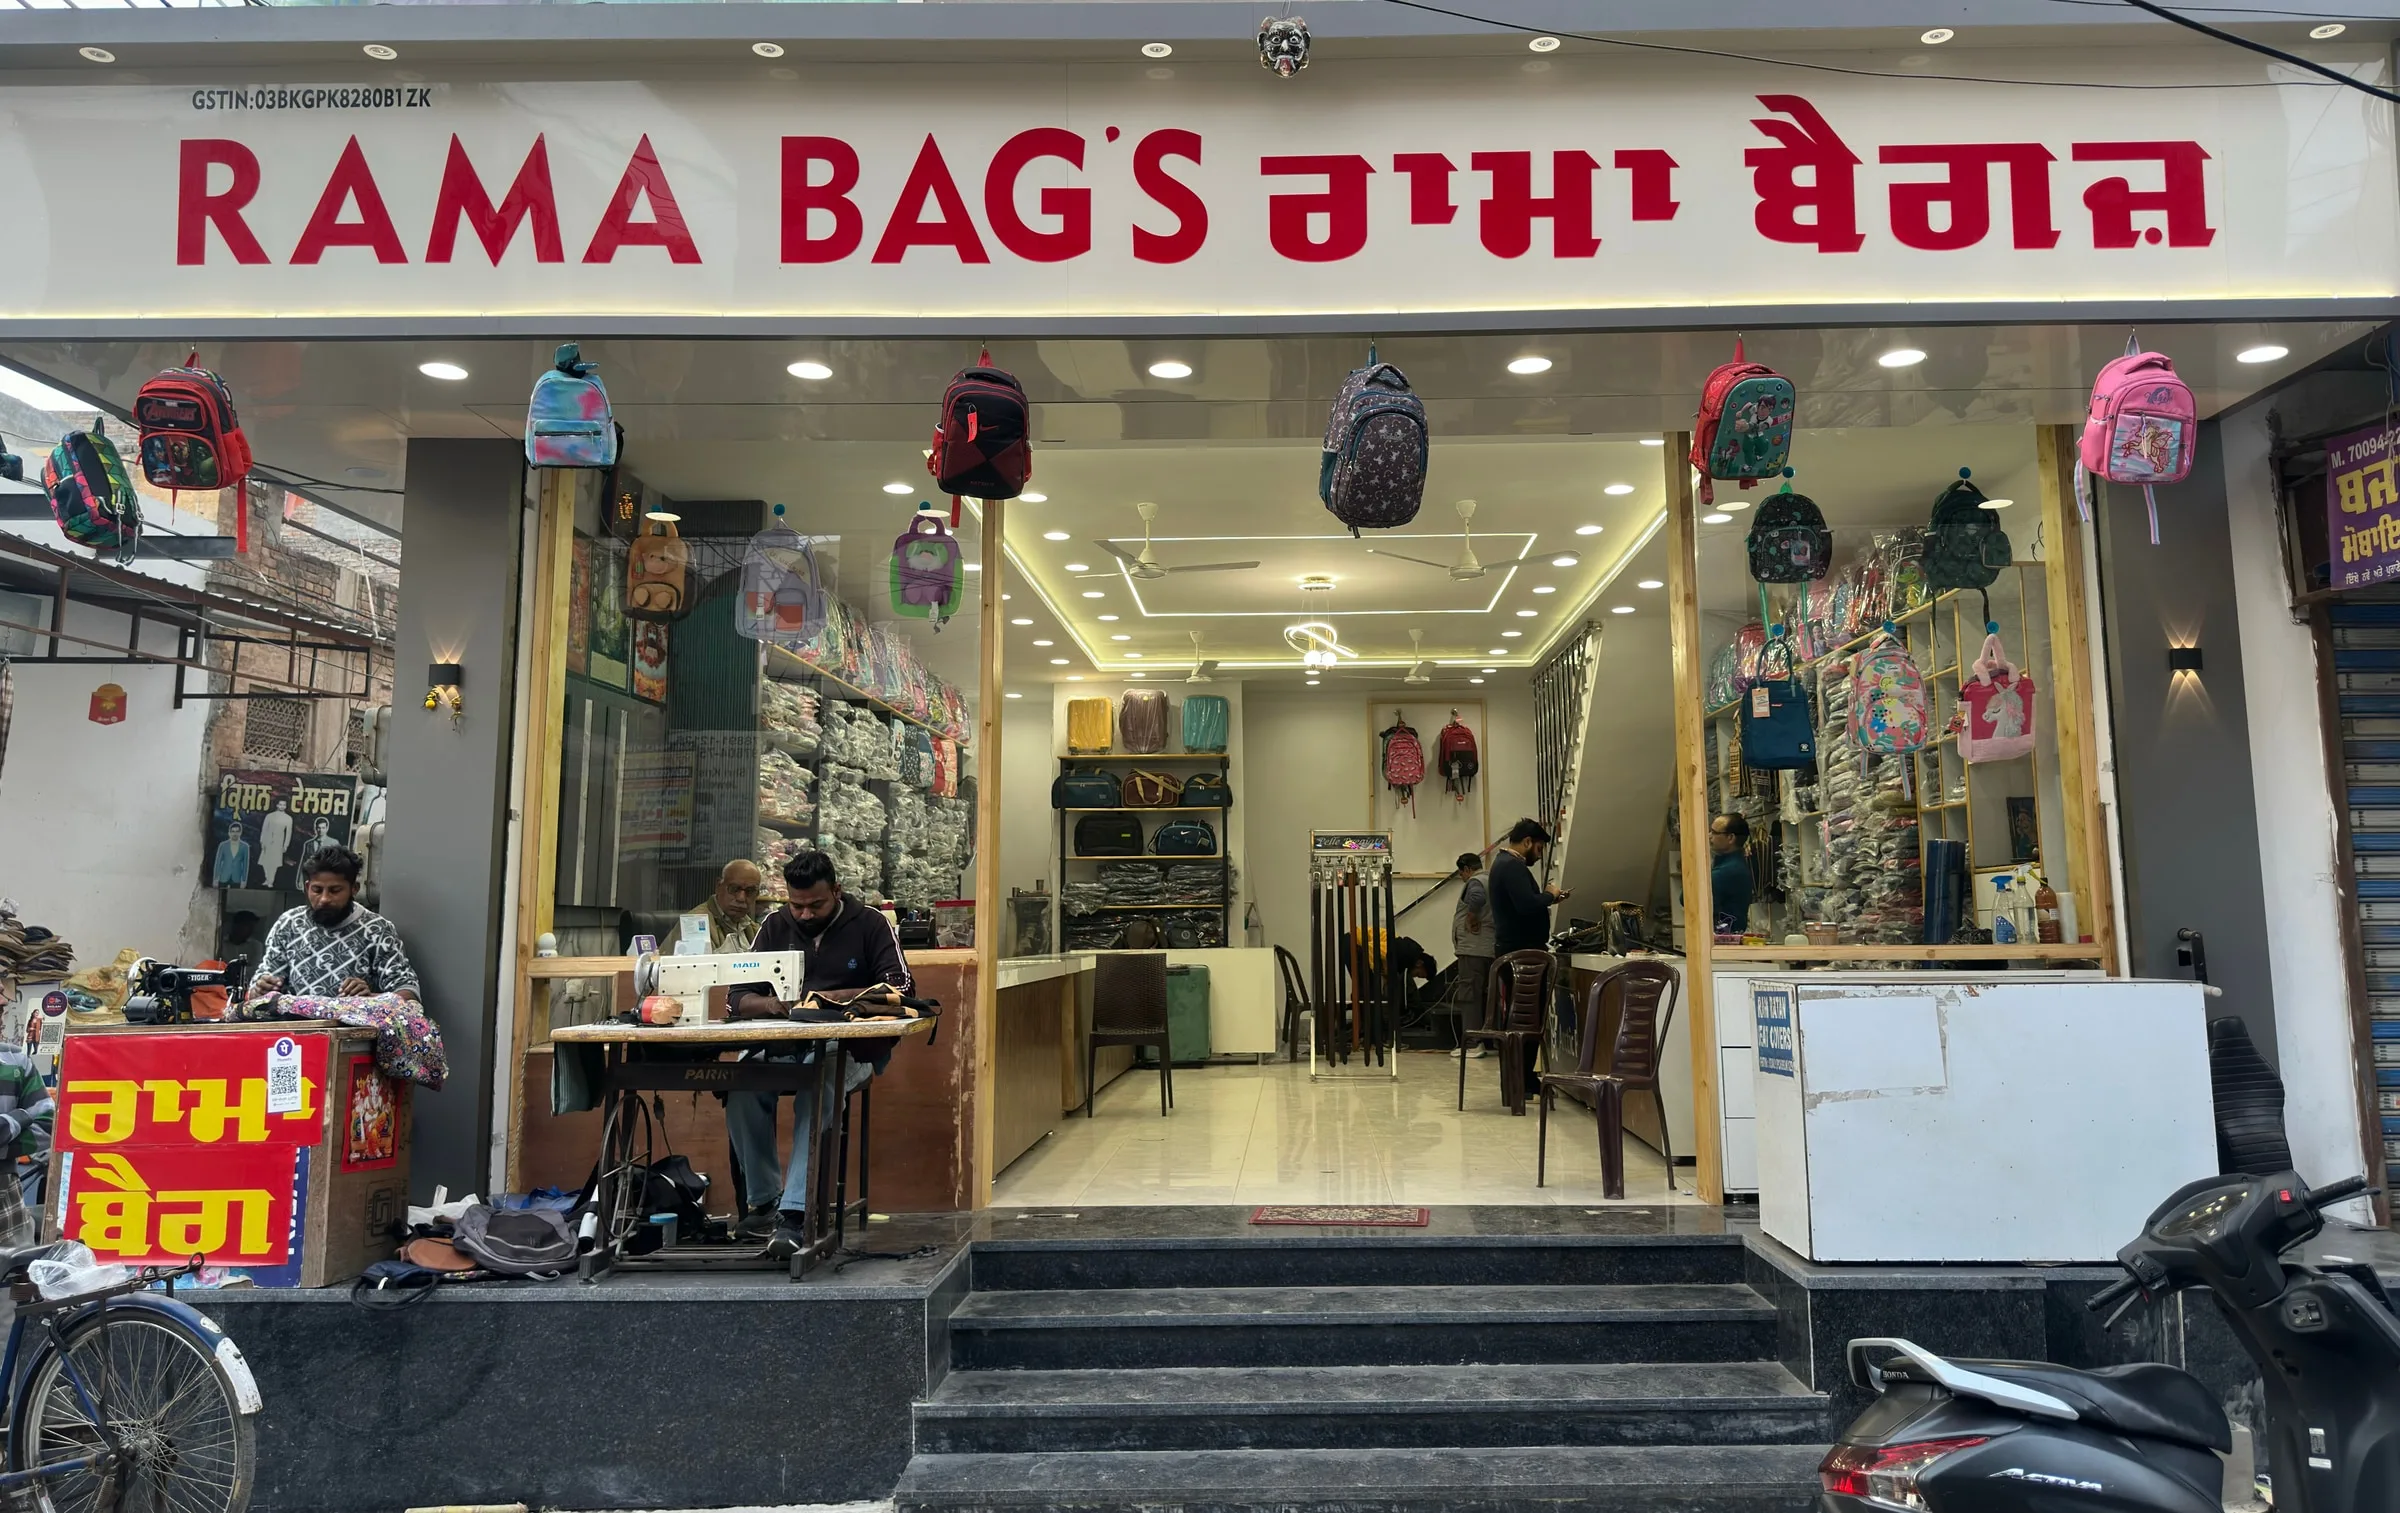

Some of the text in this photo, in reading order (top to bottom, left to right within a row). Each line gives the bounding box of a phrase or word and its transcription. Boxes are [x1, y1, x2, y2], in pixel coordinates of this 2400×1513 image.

[177, 125, 1209, 267] RAMA BAG'S
[1260, 94, 2217, 263] ਰਾਮਾ ਬੈਗਜ਼
[1769, 1026, 1792, 1051] COVERS
[67, 1076, 318, 1144] ਰਾਮਾ
[76, 1152, 276, 1257] ਬੈਗ
[1882, 1370, 1910, 1380] HONDA
[1987, 1468, 2103, 1493] ACTIVA
